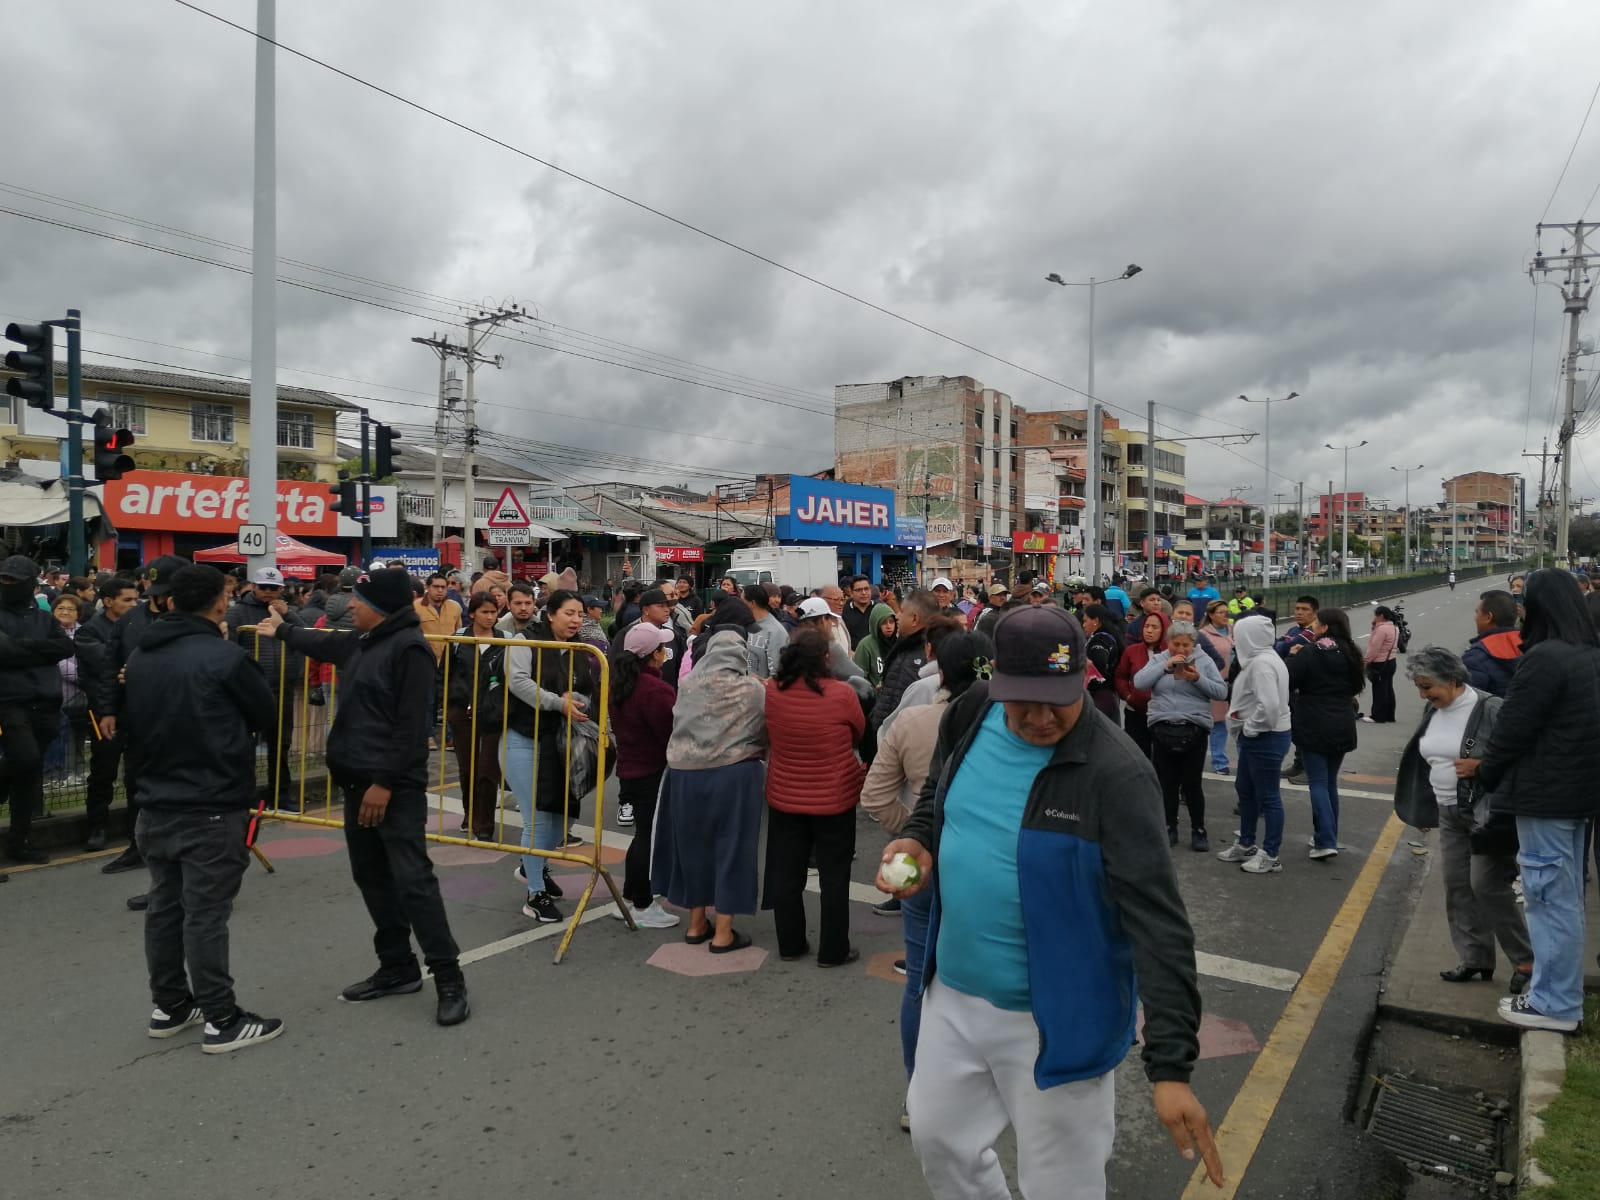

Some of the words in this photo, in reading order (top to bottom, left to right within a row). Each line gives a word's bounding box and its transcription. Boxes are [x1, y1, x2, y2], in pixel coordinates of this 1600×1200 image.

[120, 480, 325, 523] artefta
[797, 495, 889, 528] JAHER
[243, 533, 262, 548] 40
[490, 529, 528, 537] PRIORIDAD
